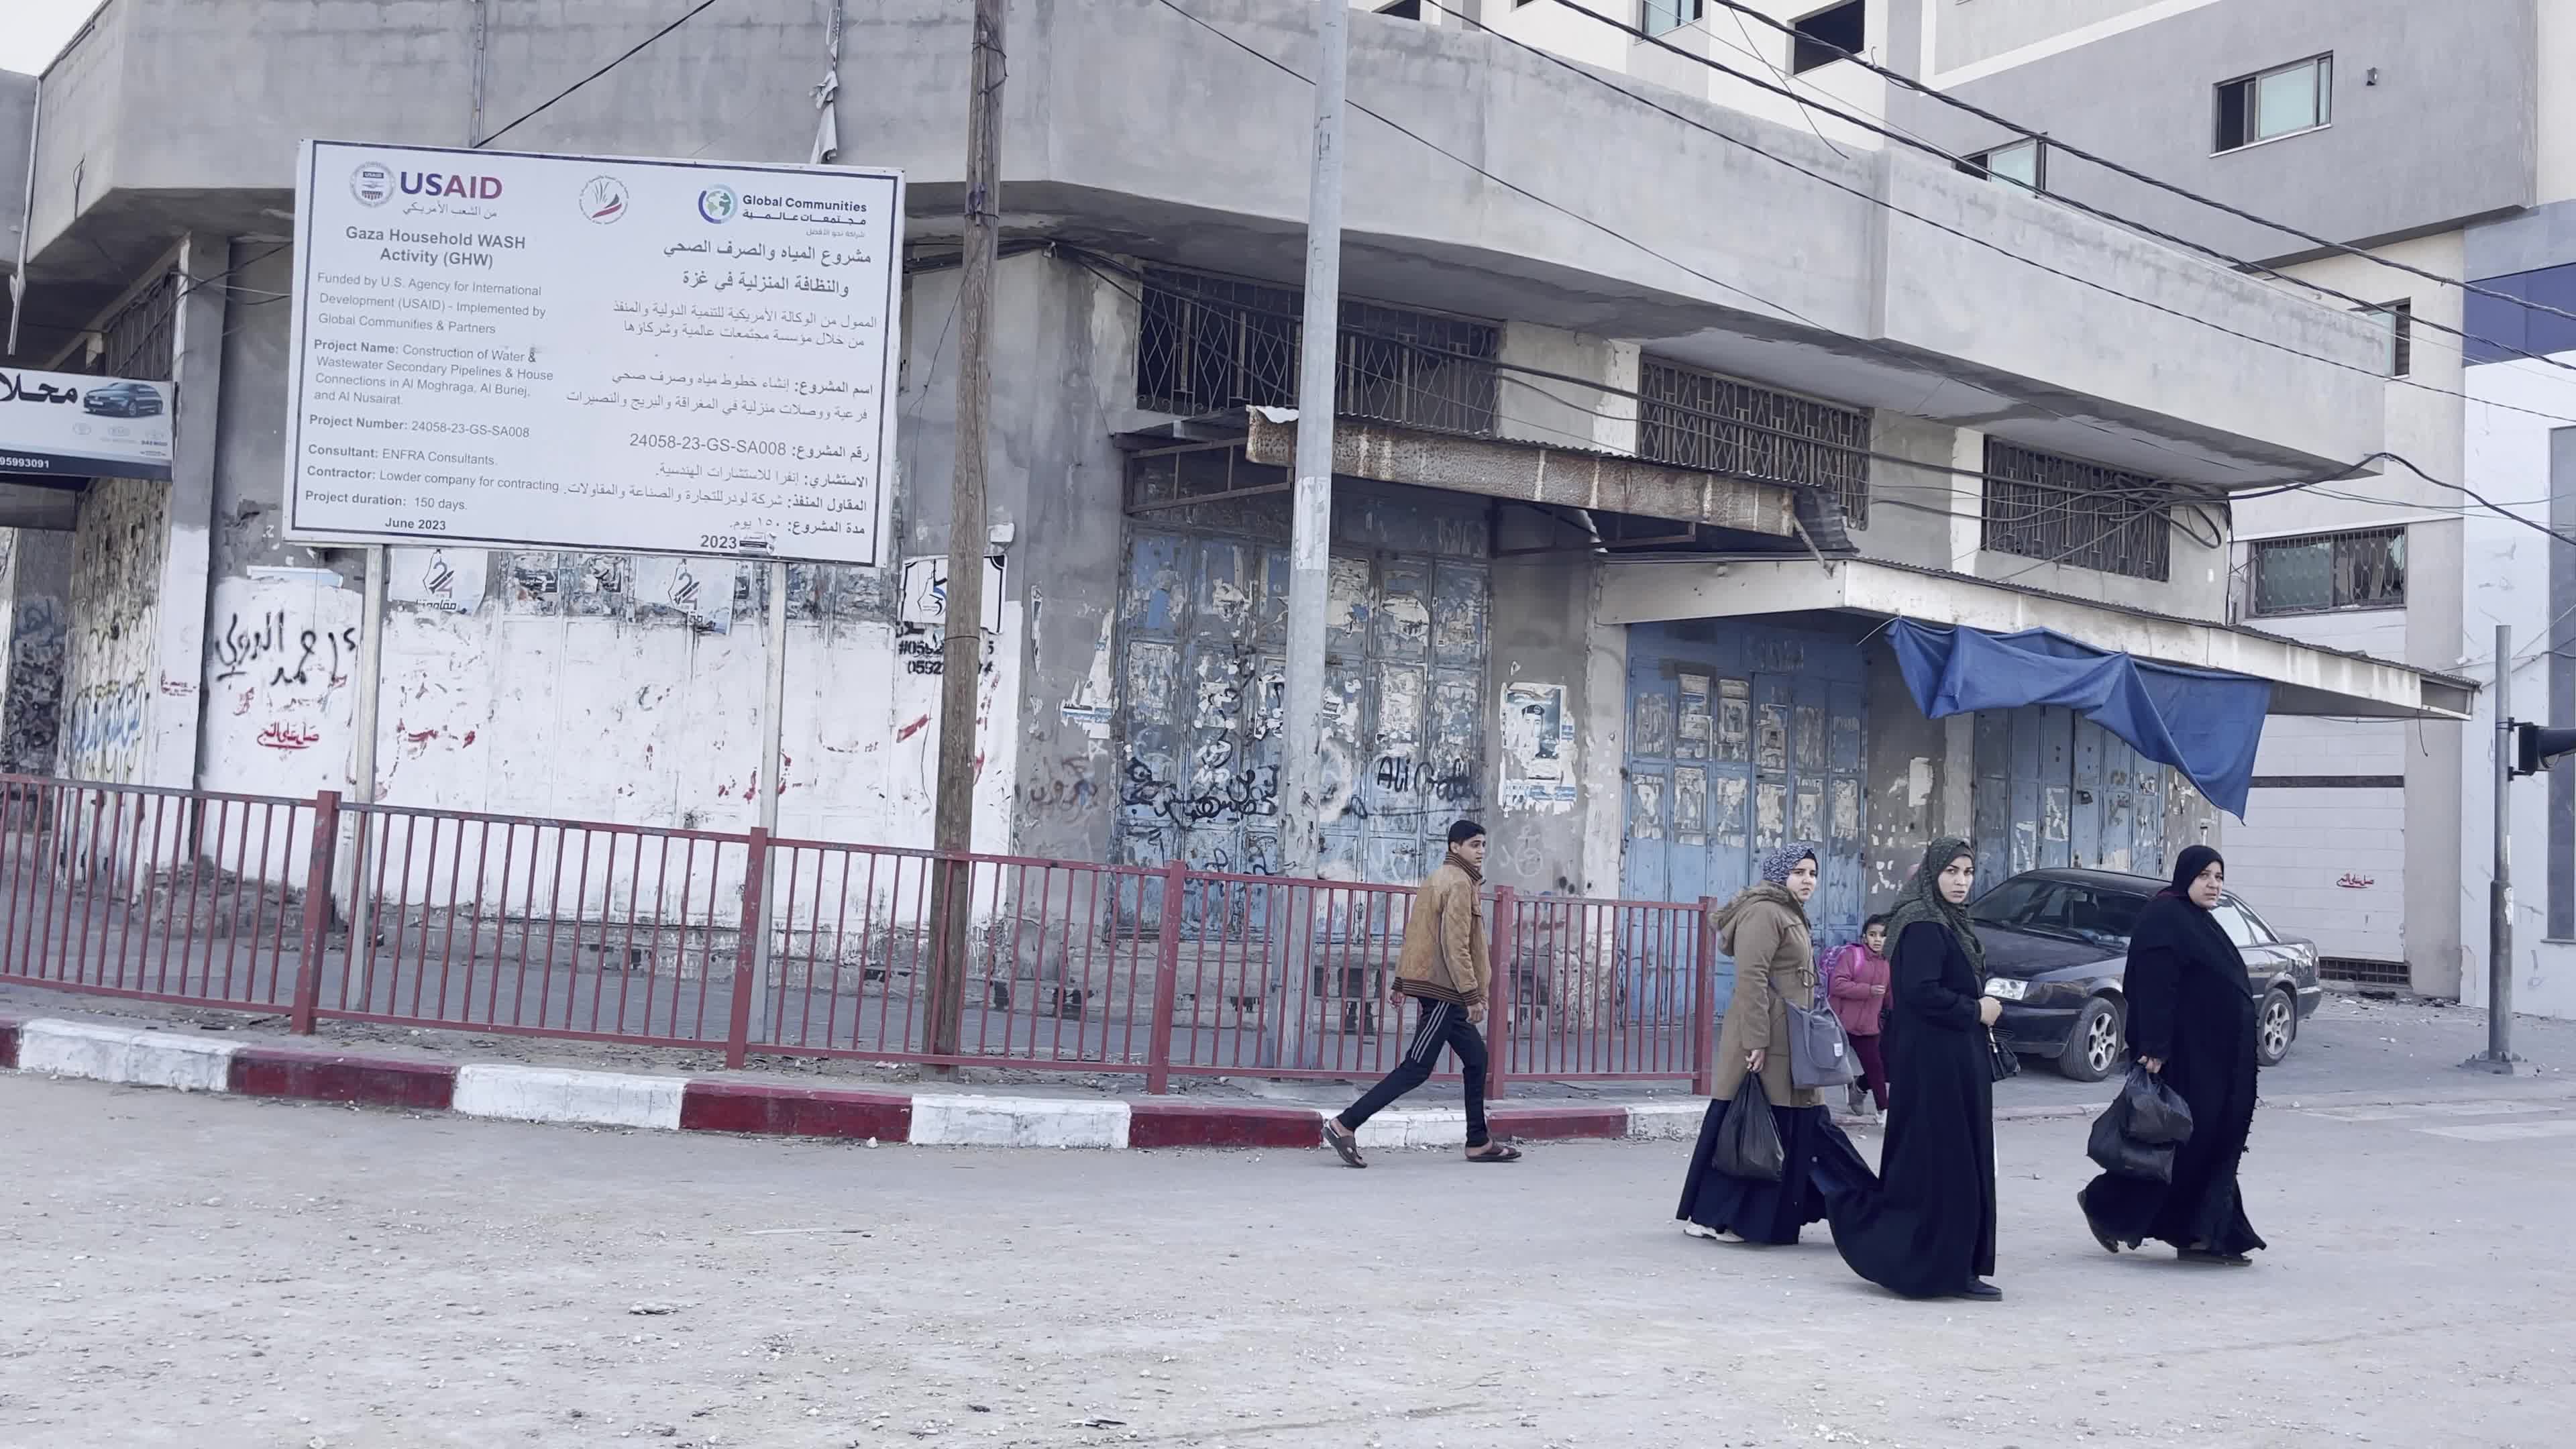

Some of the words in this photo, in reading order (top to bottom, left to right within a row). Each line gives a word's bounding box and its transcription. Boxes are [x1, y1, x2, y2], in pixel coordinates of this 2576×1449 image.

[400, 171, 502, 199] USAID
[402, 201, 447, 215] الأمريكي
[451, 205, 481, 216] الشعب
[743, 195, 782, 207] Global
[786, 198, 867, 212] Communities
[484, 211, 497, 219] من
[743, 209, 798, 221] عالمية
[801, 215, 866, 225] مجتمعات
[346, 226, 384, 240] Gaza
[390, 229, 472, 246] Household
[478, 234, 525, 249] WASH
[663, 240, 710, 257] الصحي
[717, 241, 775, 261] والصرف
[782, 246, 814, 262] المياه
[380, 248, 438, 266] Activity
[444, 252, 492, 270] (GHW)
[821, 249, 871, 267] مشروع
[317, 272, 360, 284] Funded
[364, 276, 377, 288] by
[381, 276, 405, 288] U.S.
[408, 278, 451, 292] Agency
[454, 281, 469, 291] for
[473, 282, 541, 295] International
[683, 270, 708, 288] غزة
[714, 272, 733, 292] في
[739, 272, 788, 292] المنزلية
[794, 275, 849, 297] والنظافة
[320, 292, 394, 308] Development
[398, 298, 445, 312] (USAID)
[457, 302, 529, 315] Implemented
[533, 306, 546, 319] by
[613, 301, 649, 317] والمنفذ
[653, 303, 686, 318] الدولية
[691, 305, 724, 319] للتنمية
[319, 313, 355, 325] Global
[360, 315, 433, 330] Communities
[437, 320, 443, 331] &
[449, 321, 496, 333] Partners
[728, 307, 776, 323] الأمريكية
[781, 311, 816, 327] الوكالة
[821, 317, 837, 327] من
[841, 315, 876, 329] الممول
[682, 323, 714, 337] عالمية
[720, 327, 769, 339] مجتمعات
[773, 329, 812, 345] مؤسسة
[816, 333, 844, 345] خلال
[848, 338, 864, 349] من
[315, 339, 357, 352] Project
[362, 342, 398, 354] Name:
[402, 344, 473, 358] Construction
[477, 350, 488, 360] of
[492, 350, 525, 362] Water
[528, 351, 536, 362] &
[317, 356, 384, 370] Wastewater
[386, 360, 447, 376] Secondary
[451, 364, 501, 377] Pipelines
[505, 368, 513, 378] &
[517, 369, 553, 380] House
[316, 372, 386, 386] Connections
[390, 378, 398, 388] in
[401, 378, 413, 388] Al
[480, 383, 491, 393] Al
[612, 373, 645, 384] صحي
[650, 371, 693, 386] وصرف
[698, 373, 717, 386] مياه
[720, 374, 757, 388] خطوط
[795, 381, 848, 395] المشروع:
[853, 385, 872, 397] اسم
[314, 392, 335, 400] and
[338, 392, 350, 401] Al
[566, 392, 627, 407] والنصيرات
[631, 394, 671, 410] والبريج
[676, 396, 718, 412] المغراقة
[722, 403, 737, 415] في
[741, 400, 775, 416] منزلية
[780, 404, 830, 420] ووصلات
[834, 407, 867, 423] فرعية
[310, 414, 352, 428] Project
[356, 417, 407, 429] Number:
[411, 421, 529, 437] 24058-23-GS-SA008
[630, 433, 786, 455] 24058-23-GS-SA008
[309, 444, 378, 458] Consultant:
[383, 448, 425, 461] ENFRA
[428, 451, 497, 465] Consultants.
[792, 445, 845, 460] المشروع:
[850, 446, 869, 462] رقم
[307, 466, 375, 479] Contractor:
[380, 470, 421, 482] Lowder
[425, 475, 476, 488] company
[480, 476, 494, 486] for
[498, 479, 558, 493] contracting
[707, 467, 770, 481] للاستشارات
[805, 474, 867, 488] الاستشاري:
[306, 490, 347, 504] Project
[352, 494, 406, 506] duration:
[415, 497, 435, 508] 150
[438, 499, 467, 512] days.
[629, 485, 681, 502] والصناعة
[751, 492, 782, 508] شركة
[788, 494, 822, 508] المنفذ:
[827, 498, 866, 513] المقاول
[385, 517, 414, 529] June
[419, 519, 445, 530] 2023
[757, 517, 780, 527] ١٥٠
[788, 521, 841, 535] المشروع:
[847, 523, 865, 534] مدة
[700, 535, 737, 549] 2023
